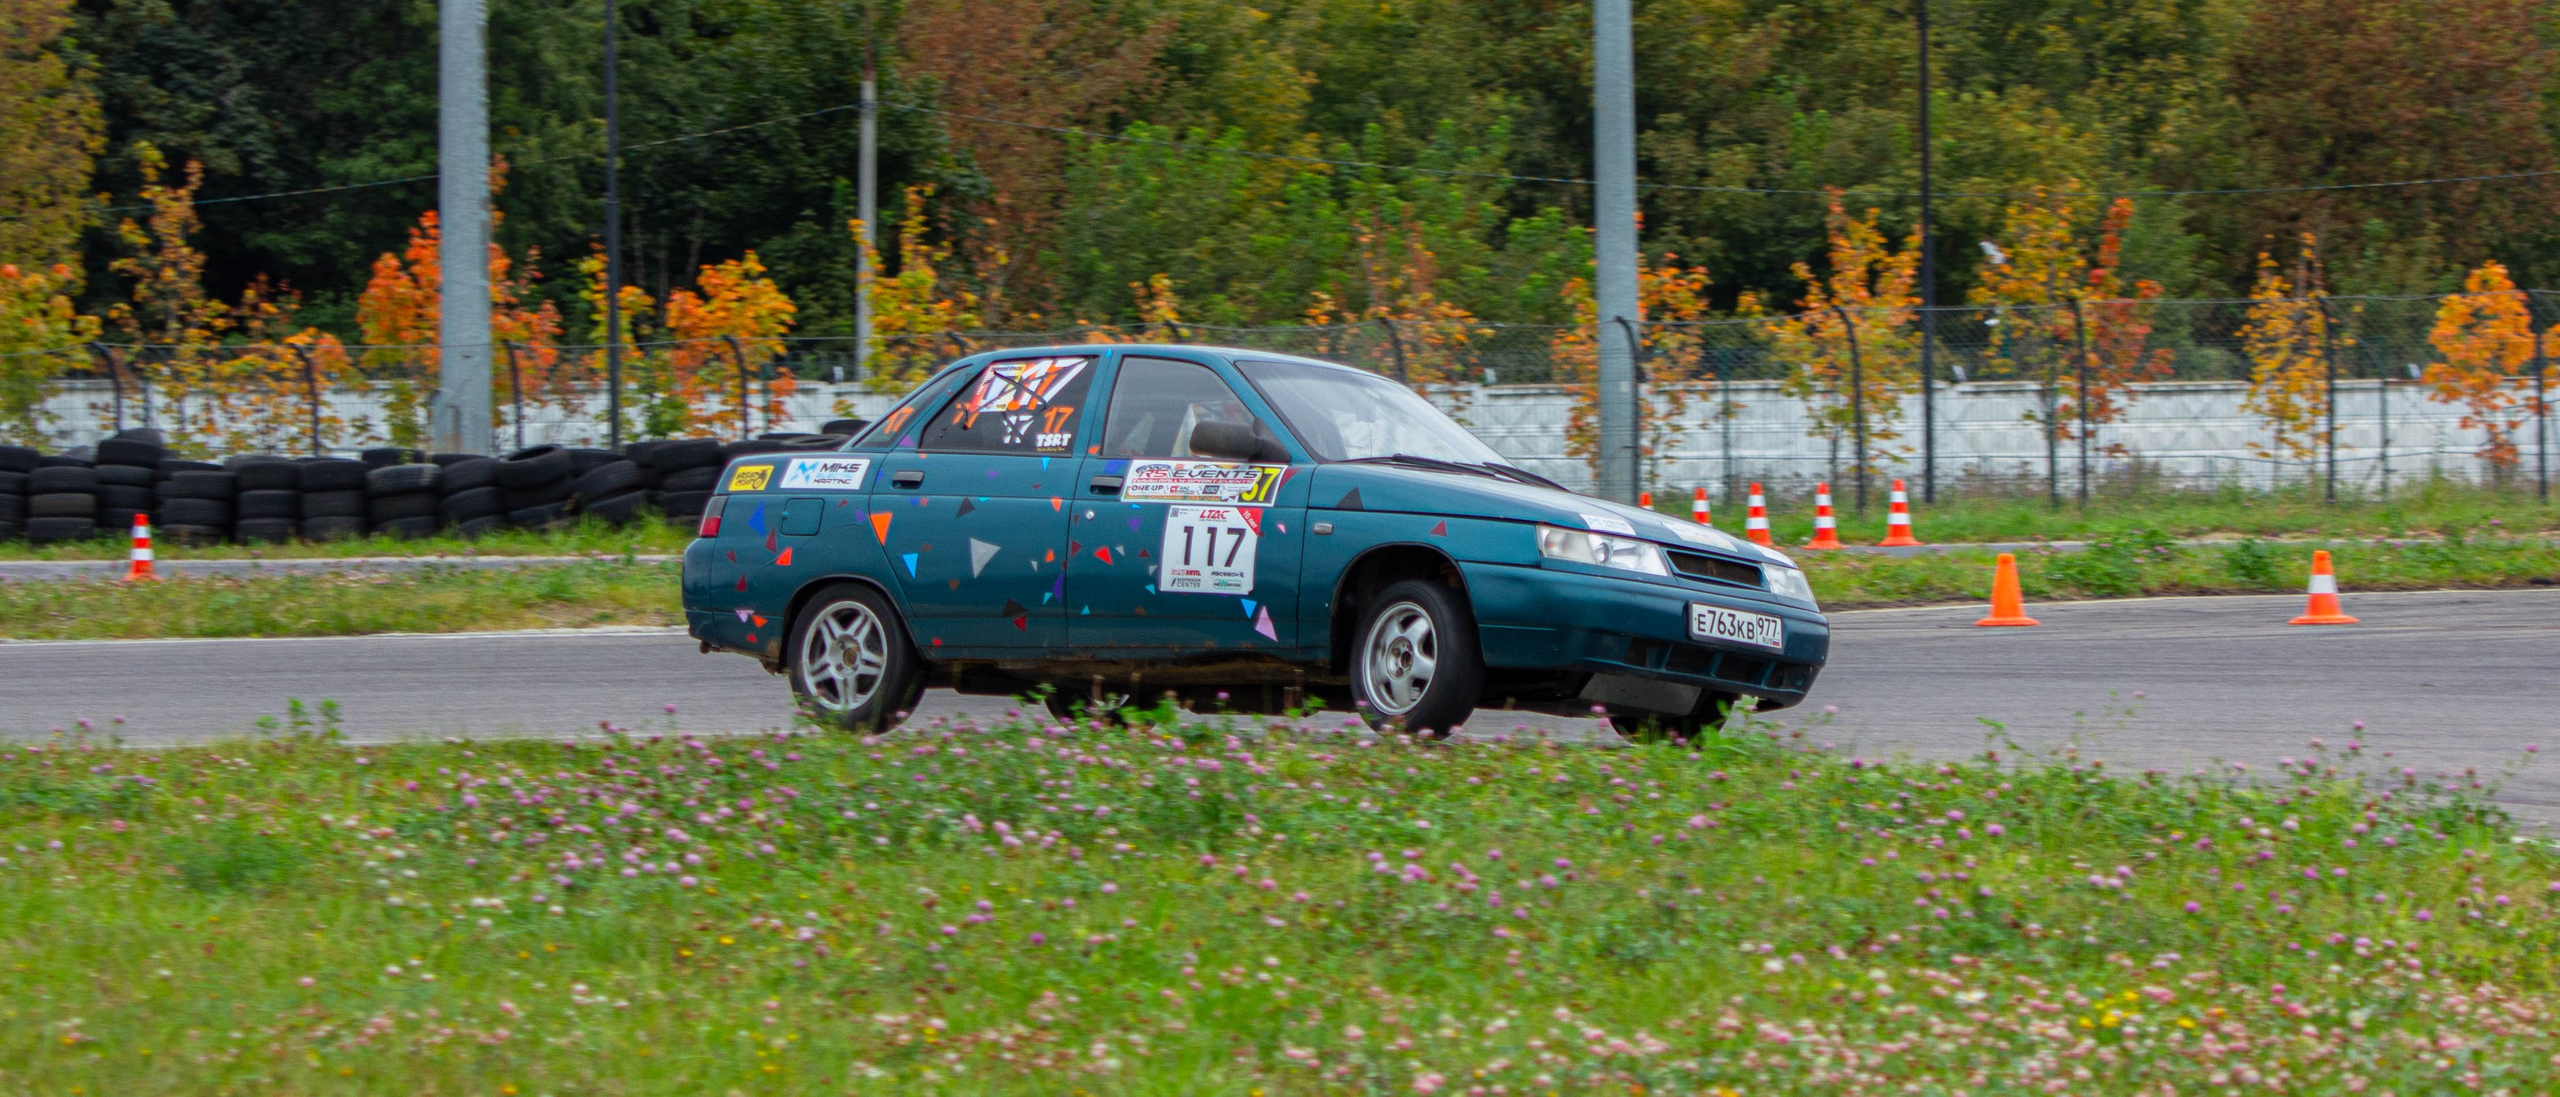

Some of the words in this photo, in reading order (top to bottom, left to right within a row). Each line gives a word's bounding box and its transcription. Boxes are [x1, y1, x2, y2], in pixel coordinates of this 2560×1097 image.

[884, 407, 914, 435] 17
[1044, 406, 1074, 434] 17
[1036, 433, 1071, 447] TSRT
[819, 462, 862, 473] MIKS
[1172, 469, 1259, 478] EVENTS
[1200, 509, 1230, 519] LTAC
[1183, 526, 1246, 567] 117
[1697, 609, 1755, 640] Е763КВ
[1757, 617, 1777, 637] 977
